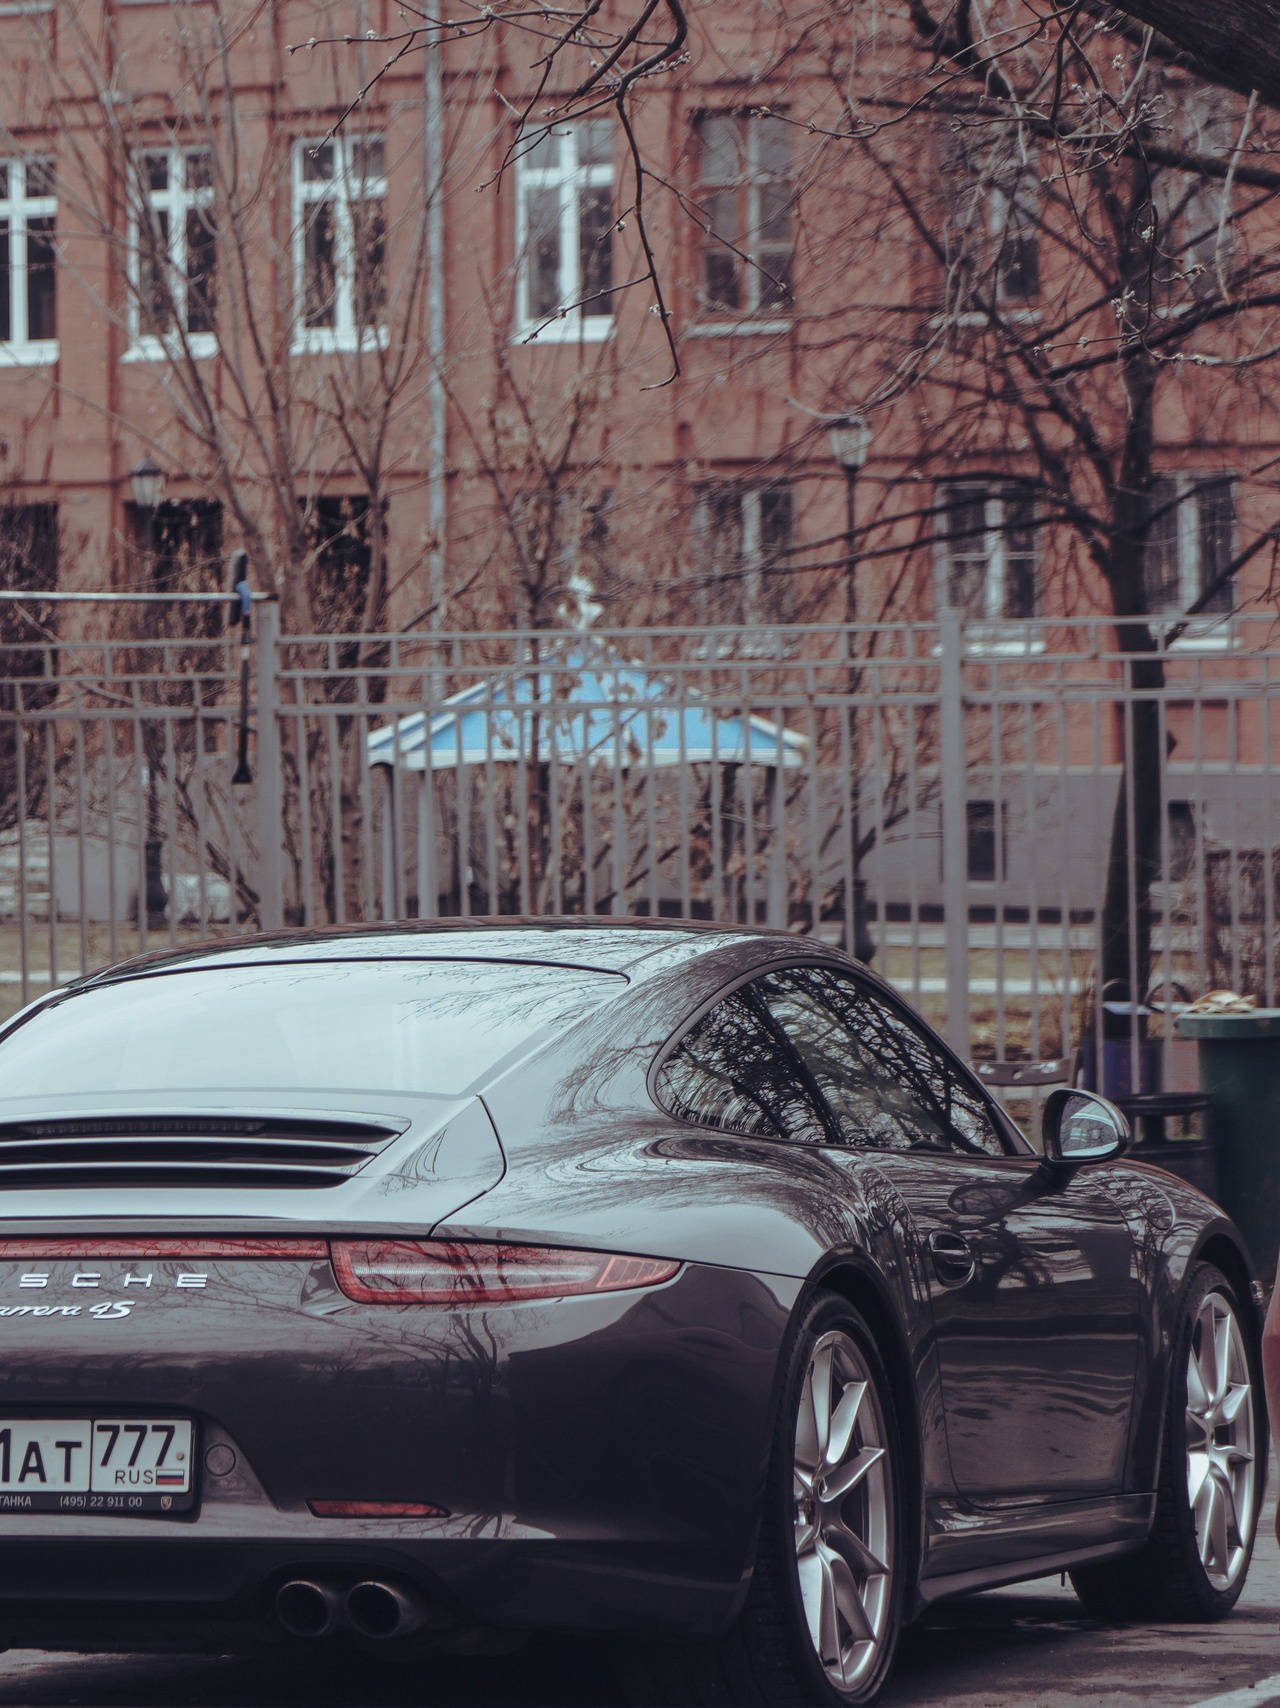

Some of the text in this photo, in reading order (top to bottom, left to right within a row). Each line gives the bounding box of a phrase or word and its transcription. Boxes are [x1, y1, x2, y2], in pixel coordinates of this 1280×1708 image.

[89, 1300, 136, 1320] 4S
[96, 1424, 176, 1467] 777
[115, 1469, 154, 1485] RUS
[60, 1496, 143, 1508] (495) 22 911 00
